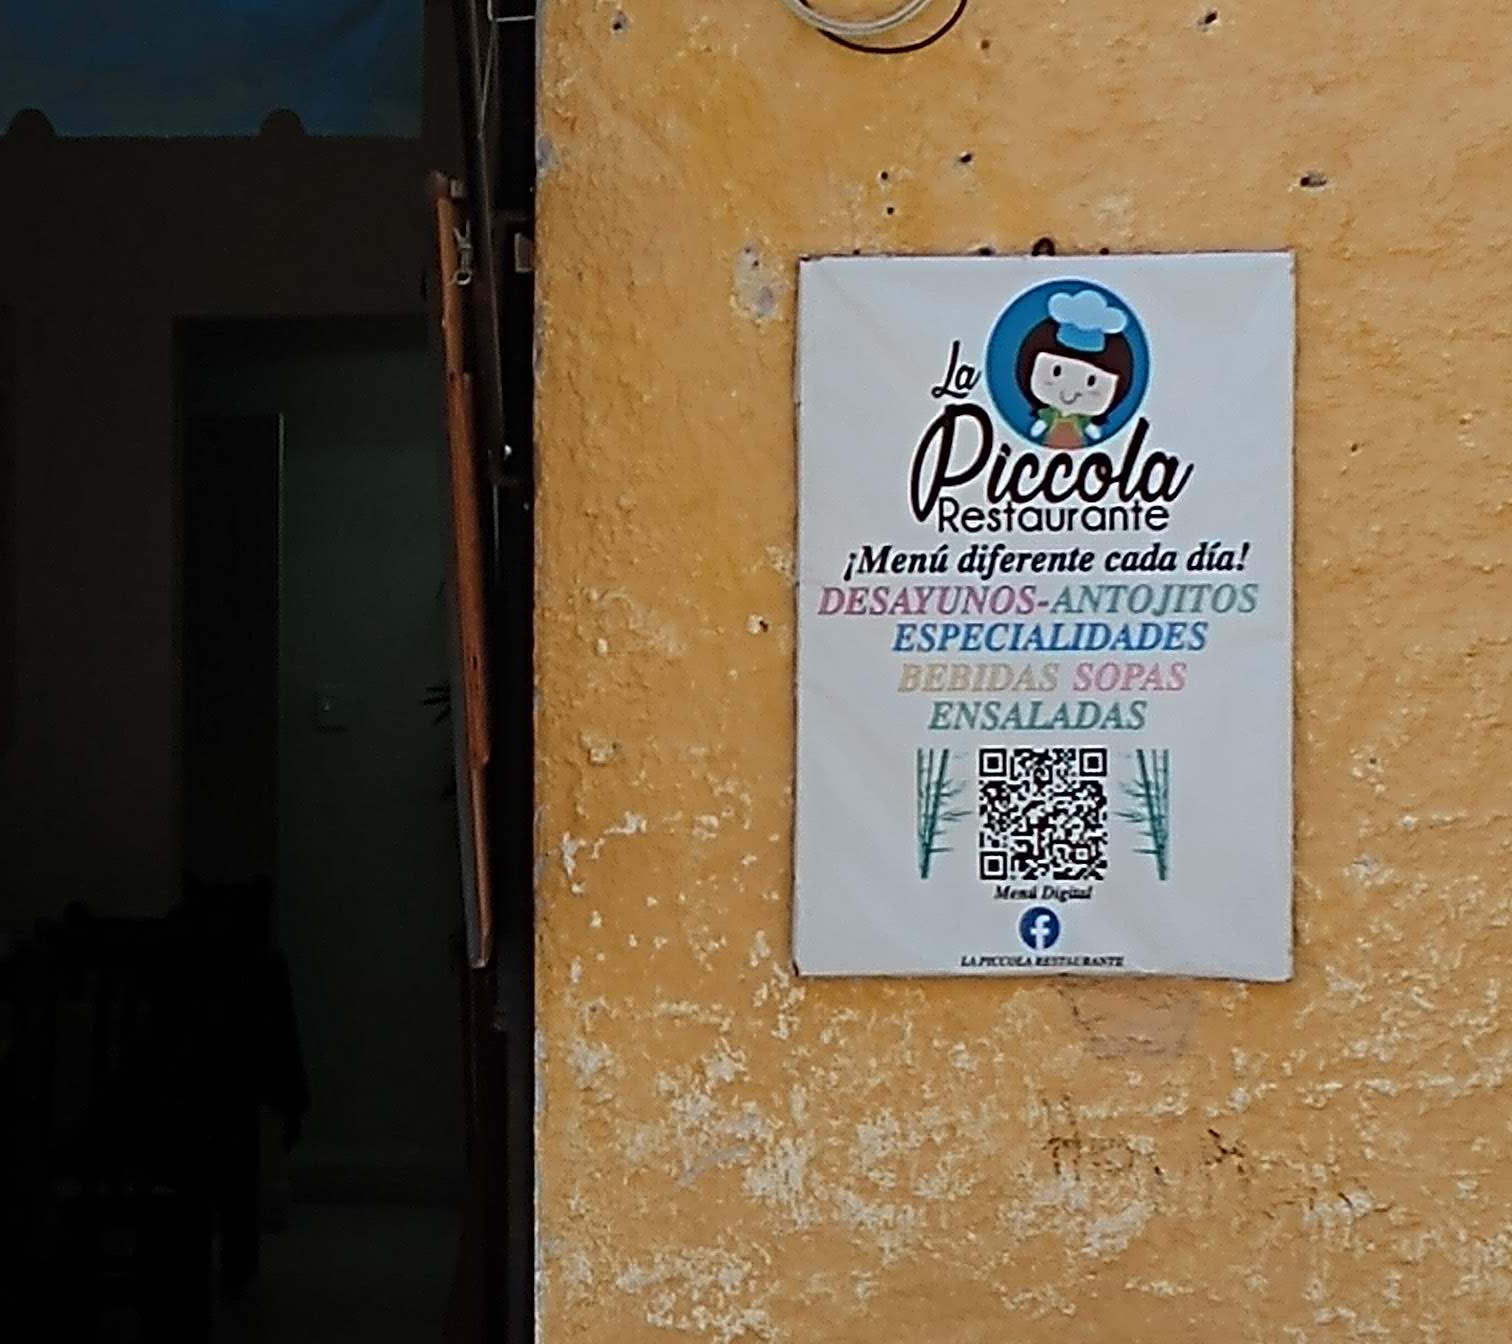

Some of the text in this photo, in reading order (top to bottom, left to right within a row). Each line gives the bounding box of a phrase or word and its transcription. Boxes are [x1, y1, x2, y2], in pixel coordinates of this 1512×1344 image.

[931, 340, 981, 399] La
[910, 403, 1195, 523] Piccola
[938, 498, 1170, 533] Restaurante
[843, 542, 1250, 581] ¡Menú diferente cada día!
[892, 620, 1209, 652] ESPECIALIDADES
[897, 662, 1187, 693] BEBIDAS SOPAS
[928, 700, 1148, 731] ENSALADAS
[993, 885, 1094, 902] Menú Digital
